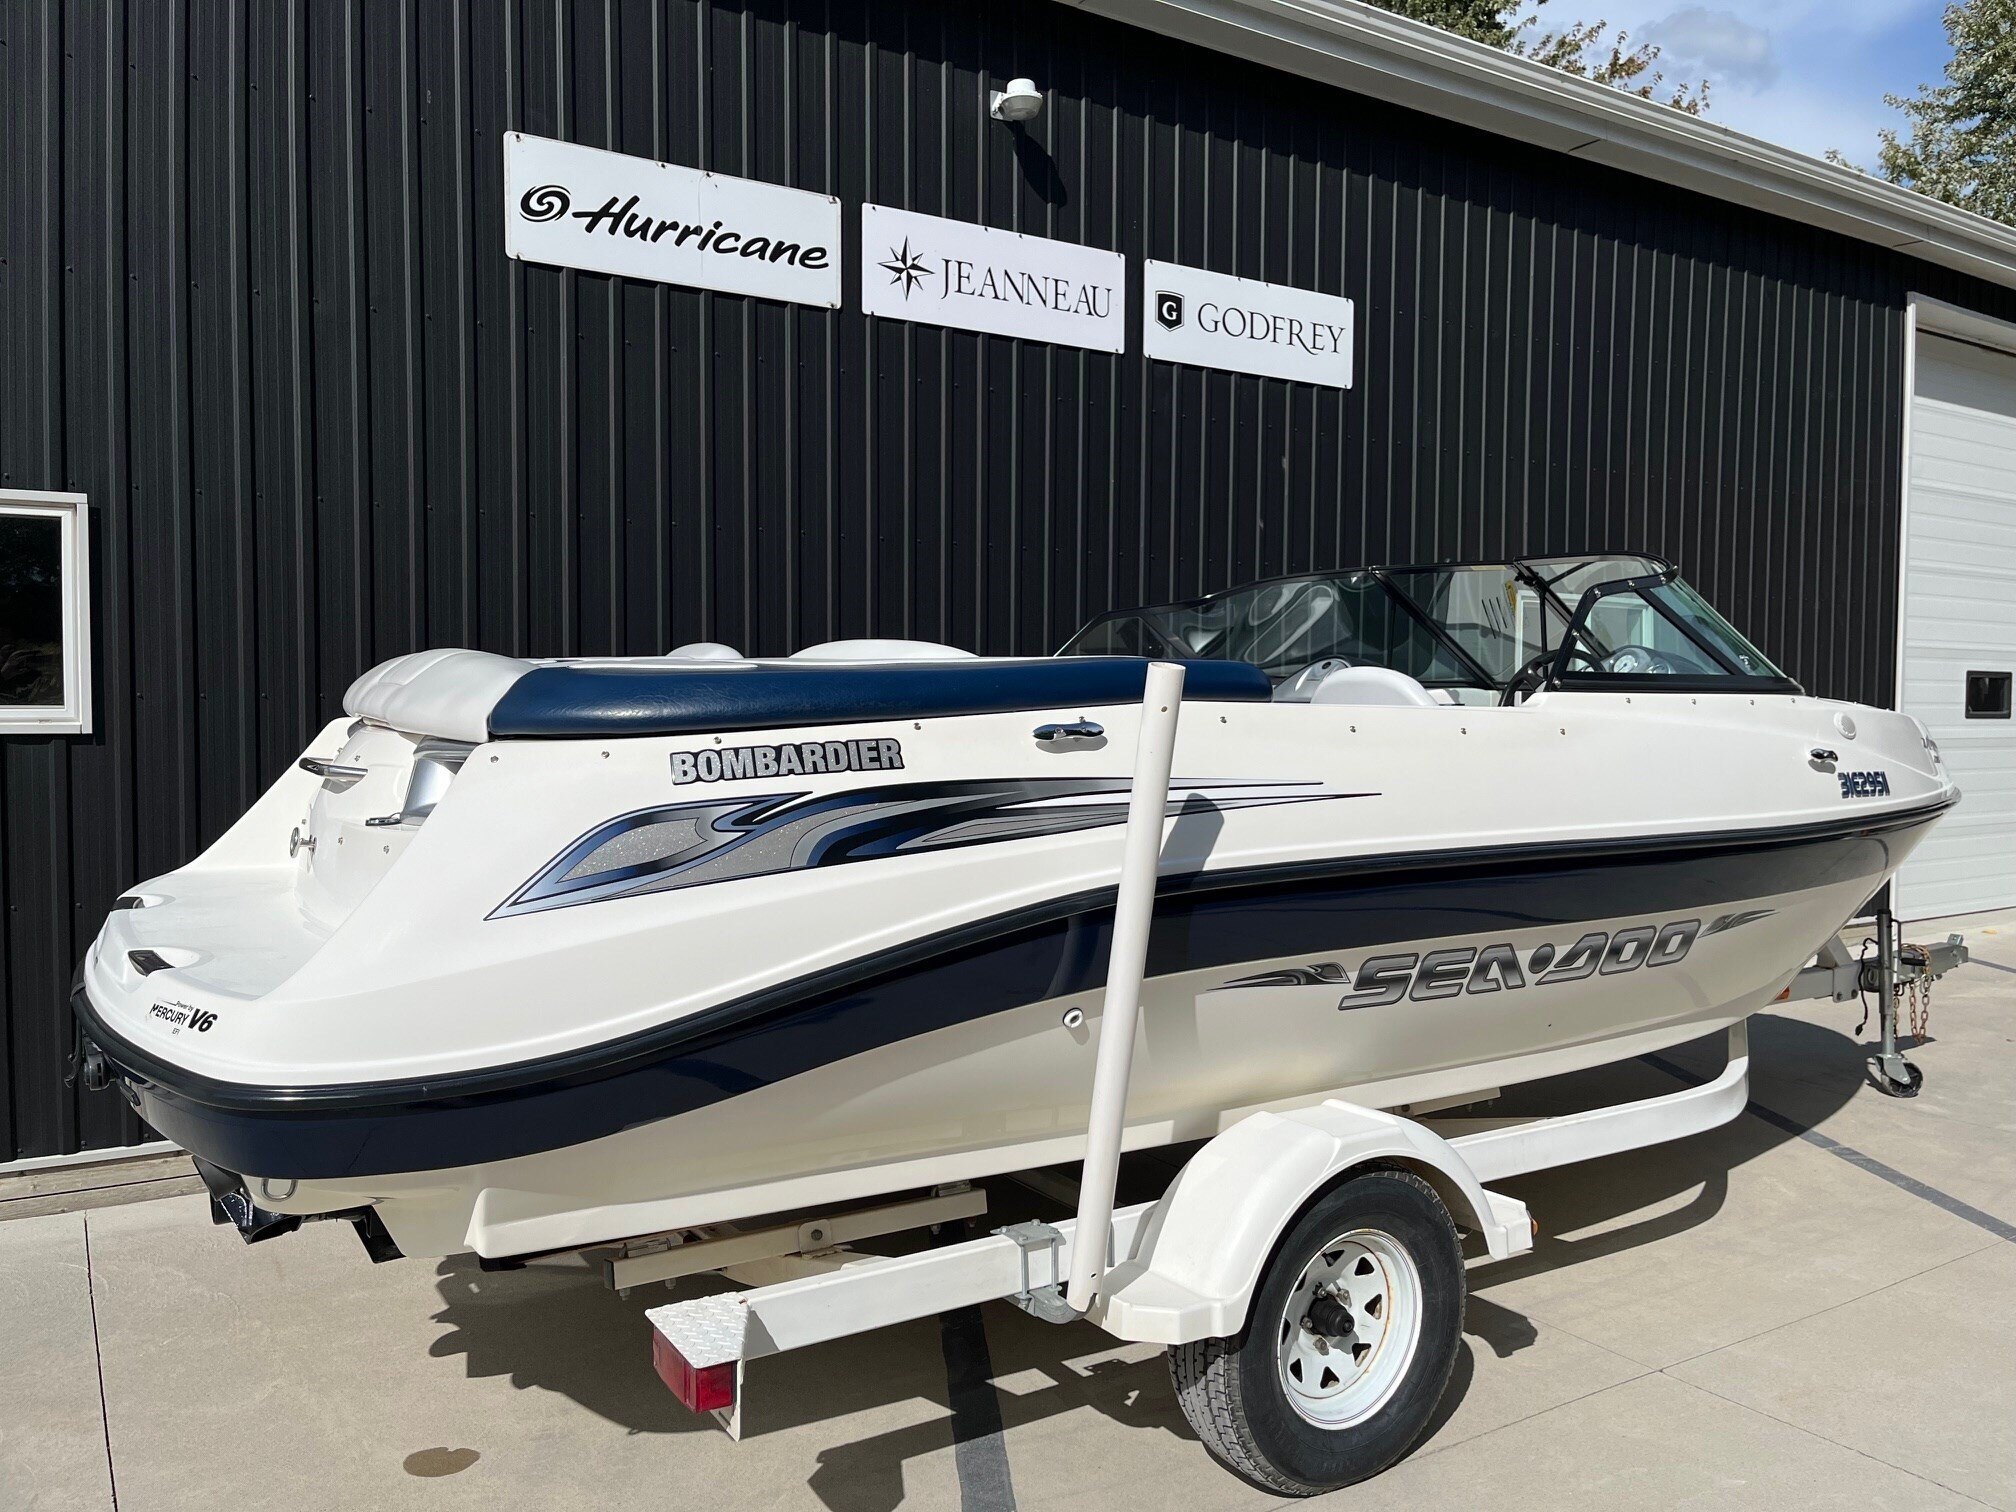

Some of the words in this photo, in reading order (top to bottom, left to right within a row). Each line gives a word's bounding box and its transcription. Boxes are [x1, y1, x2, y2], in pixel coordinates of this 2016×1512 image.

[571, 195, 830, 270] Hurricane
[941, 258, 1112, 318] JEANNEAU
[1162, 301, 1178, 320] G
[1197, 302, 1346, 355] GODFREY
[670, 738, 905, 785] BOMBARDIER
[150, 1003, 190, 1026] MERCURY
[188, 1008, 218, 1032] V6
